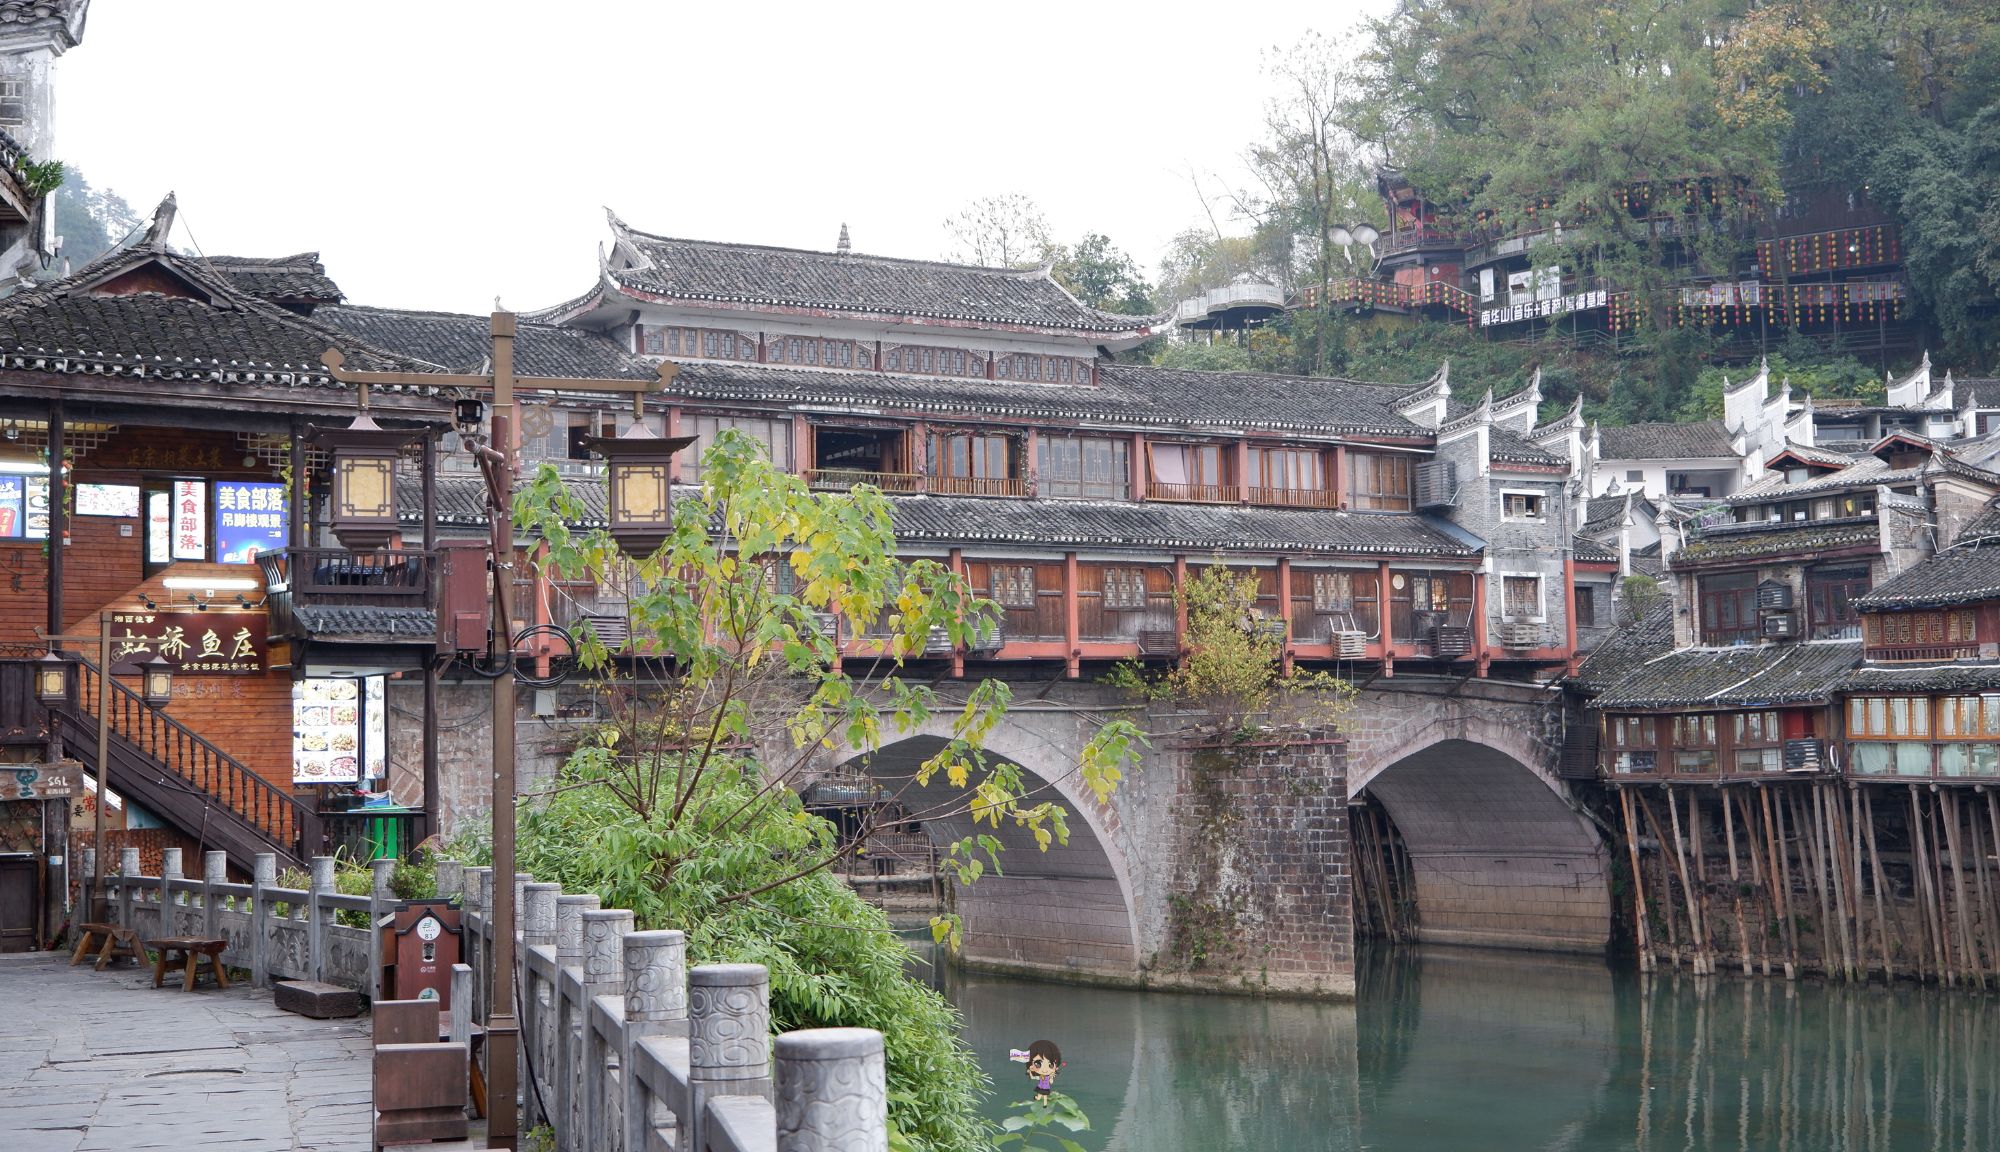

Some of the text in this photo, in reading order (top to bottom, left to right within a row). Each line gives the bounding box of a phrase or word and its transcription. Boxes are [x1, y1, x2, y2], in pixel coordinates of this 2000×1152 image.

[219, 487, 283, 511] 美食部落
[180, 481, 198, 550] 美食部落
[119, 626, 257, 660] 虹桥鱼庄
[47, 776, 68, 787] SGL
